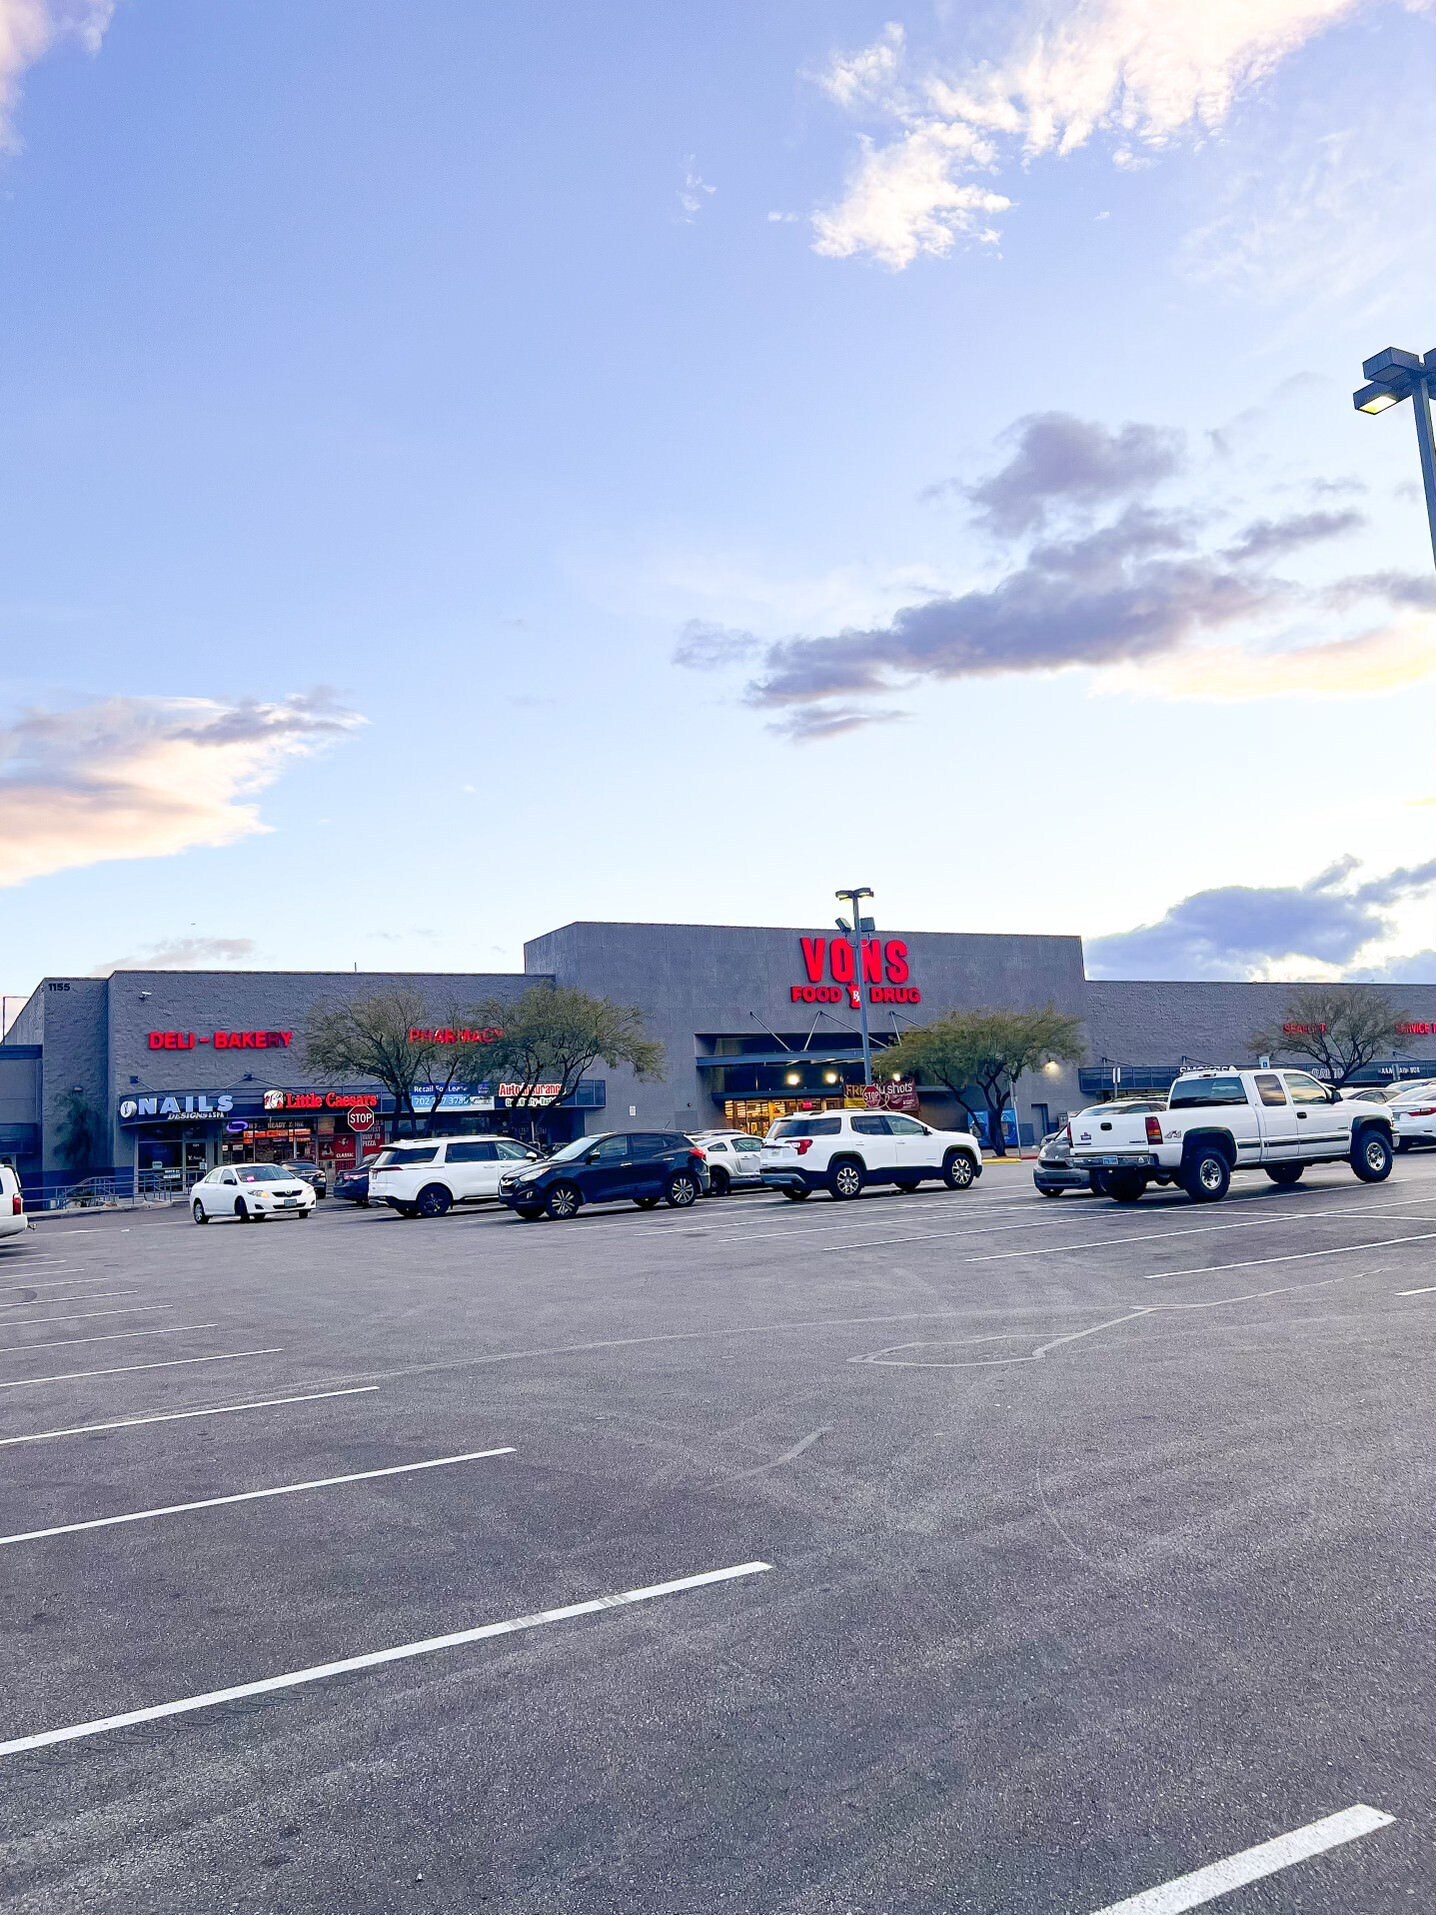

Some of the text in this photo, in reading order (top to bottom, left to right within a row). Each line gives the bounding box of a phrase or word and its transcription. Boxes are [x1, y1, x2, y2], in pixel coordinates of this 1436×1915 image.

[800, 937, 909, 984] VONS
[48, 983, 70, 991] 1155
[791, 986, 843, 1003] FOOD
[869, 987, 921, 1003] DRUG
[149, 1031, 194, 1050] DELI
[214, 1031, 293, 1049] BAKERY
[409, 1028, 503, 1044] PHARMACY
[846, 1084, 866, 1097] FRE
[888, 1082, 913, 1095] shots
[864, 1091, 879, 1101] STOP
[138, 1095, 234, 1115] NAILS
[285, 1091, 378, 1109] Little Caesars
[350, 1113, 373, 1124] STOP
